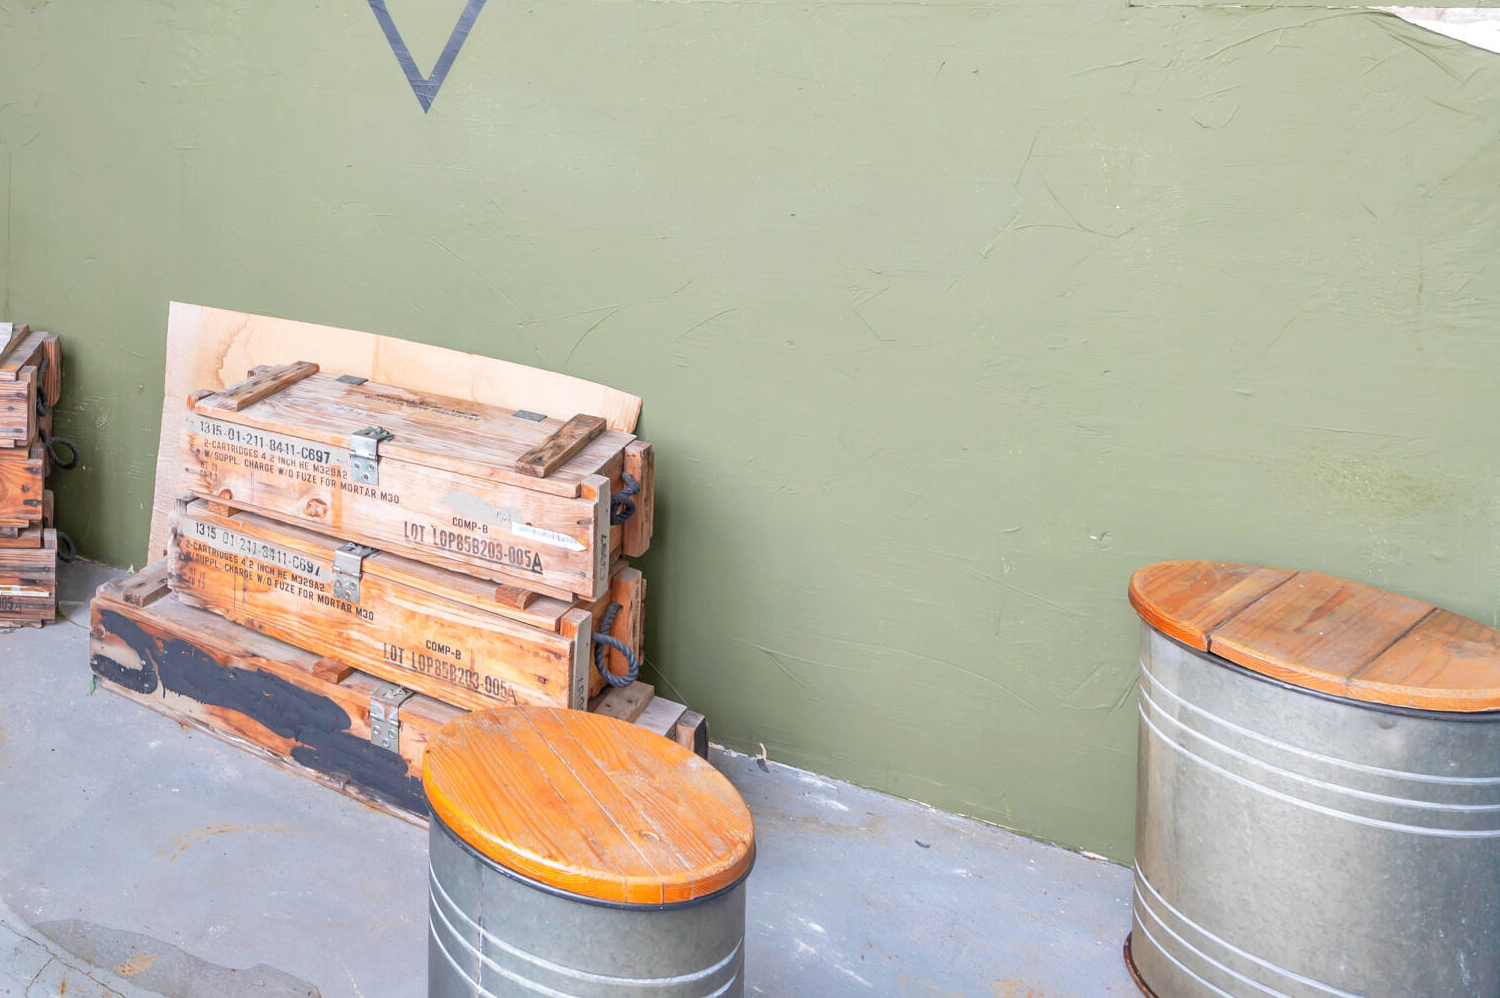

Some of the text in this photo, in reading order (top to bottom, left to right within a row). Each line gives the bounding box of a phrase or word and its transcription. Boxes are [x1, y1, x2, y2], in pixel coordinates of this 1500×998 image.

[203, 438, 259, 459] 2-CARTRIDGES
[277, 456, 296, 468] INCH
[299, 460, 309, 471] HE
[244, 458, 275, 474] CHARGE
[296, 470, 317, 484] FUZE
[320, 476, 337, 489] FOR
[340, 481, 377, 499] MORTAR
[380, 490, 400, 504] M30
[403, 521, 426, 543] LOT
[451, 517, 489, 534] COMP-B
[185, 539, 240, 564] 2-CARTRIDGES
[257, 562, 275, 576] INCH
[277, 568, 288, 580] HE
[291, 573, 326, 593] M329A2
[224, 564, 254, 581] CHARGE
[275, 581, 296, 595] FUZE
[298, 588, 315, 602] FOR
[317, 593, 353, 614] MORTAR
[355, 608, 375, 621] M30
[383, 642, 405, 664] LOT
[425, 639, 462, 660] COMP-B
